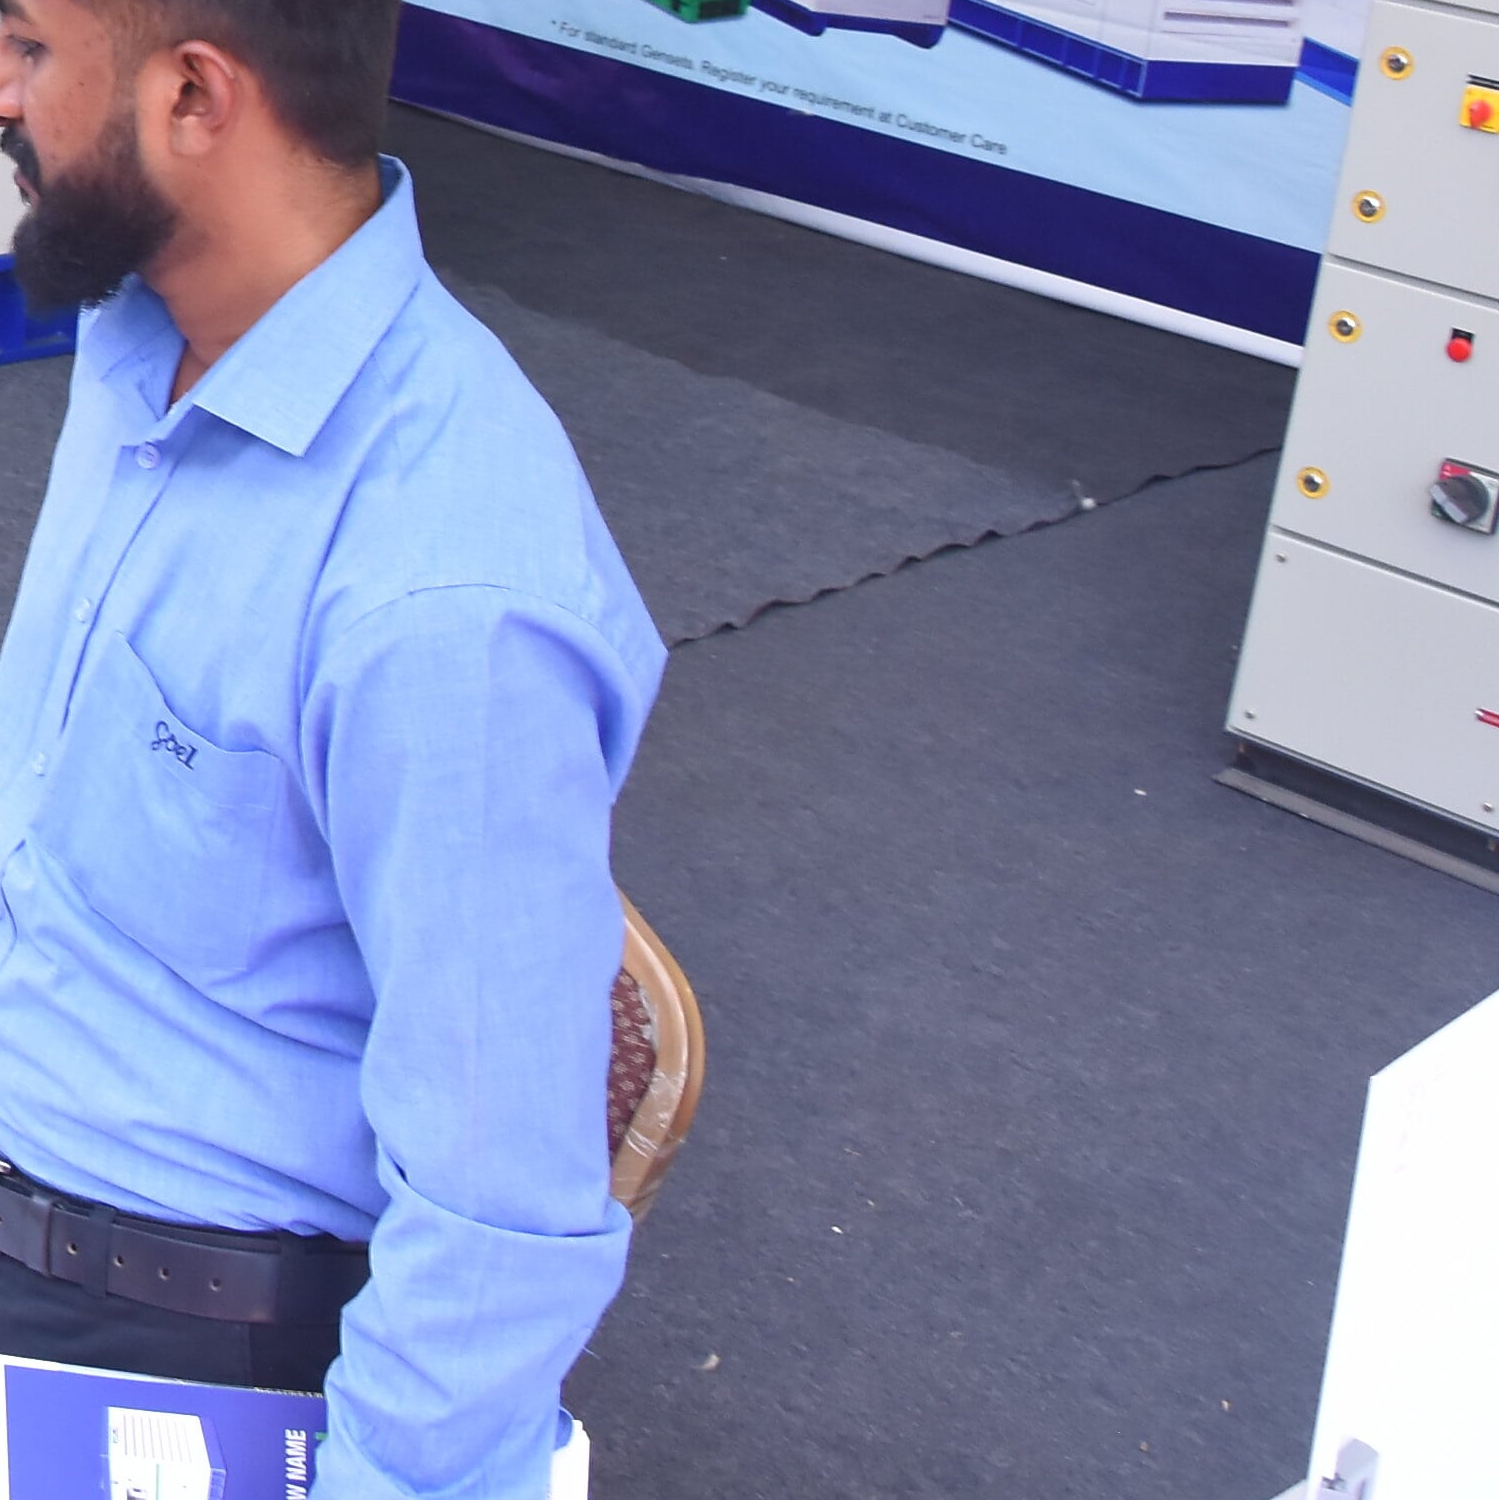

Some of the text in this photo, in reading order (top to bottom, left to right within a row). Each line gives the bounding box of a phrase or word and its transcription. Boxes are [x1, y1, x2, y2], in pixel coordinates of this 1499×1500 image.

[560, 21, 580, 37] For
[701, 59, 757, 83] Register
[760, 78, 790, 96] your
[793, 87, 875, 120] requirement
[878, 111, 892, 124] at
[896, 113, 966, 144] Customer
[970, 133, 1007, 154] Care
[284, 1429, 307, 1479] NAME
